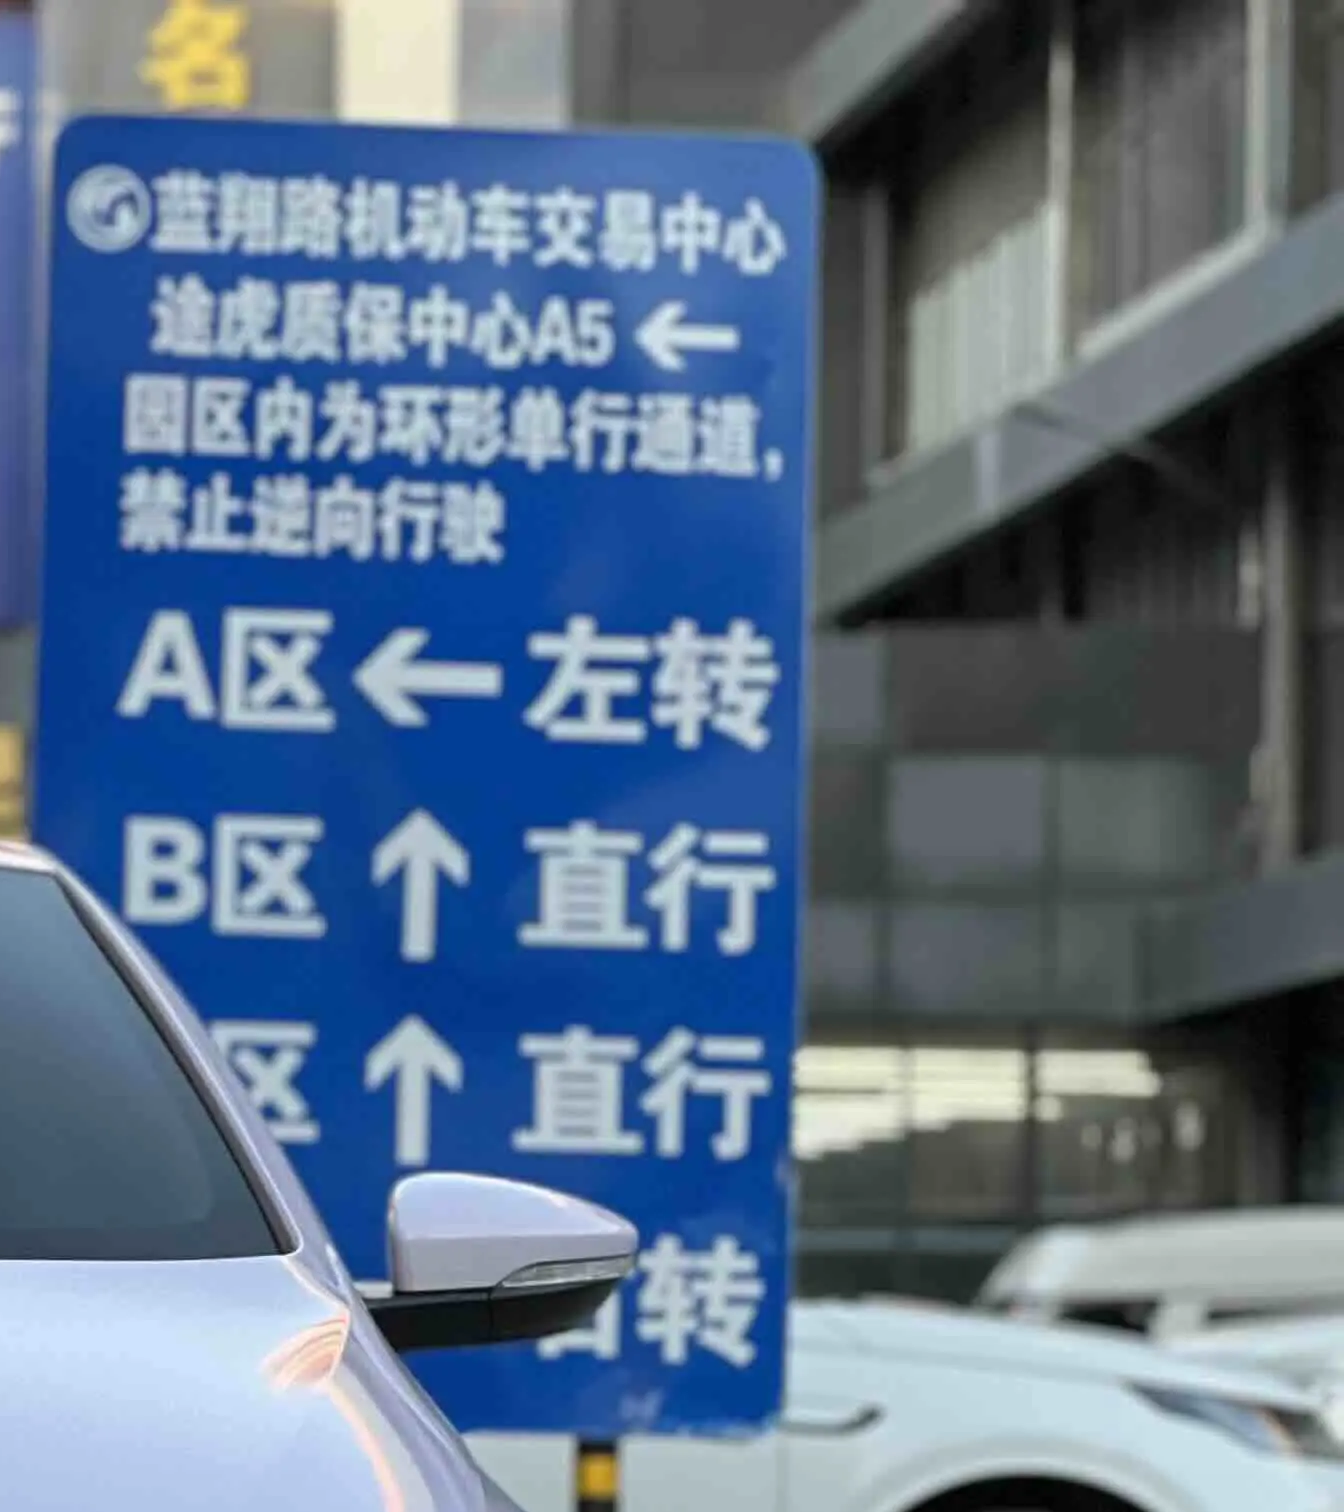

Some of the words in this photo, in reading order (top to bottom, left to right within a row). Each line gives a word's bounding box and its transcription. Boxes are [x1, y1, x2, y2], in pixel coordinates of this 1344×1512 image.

[150, 170, 786, 275] 蓝翔路机动车交易中心
[150, 274, 615, 368] 途虎质保中心A5
[119, 468, 506, 563] 禁止逆向行驶
[118, 606, 336, 732] A区
[525, 614, 780, 751] 左转
[122, 814, 326, 938] B区
[518, 820, 776, 956] 直行
[512, 1024, 771, 1160] 直行
